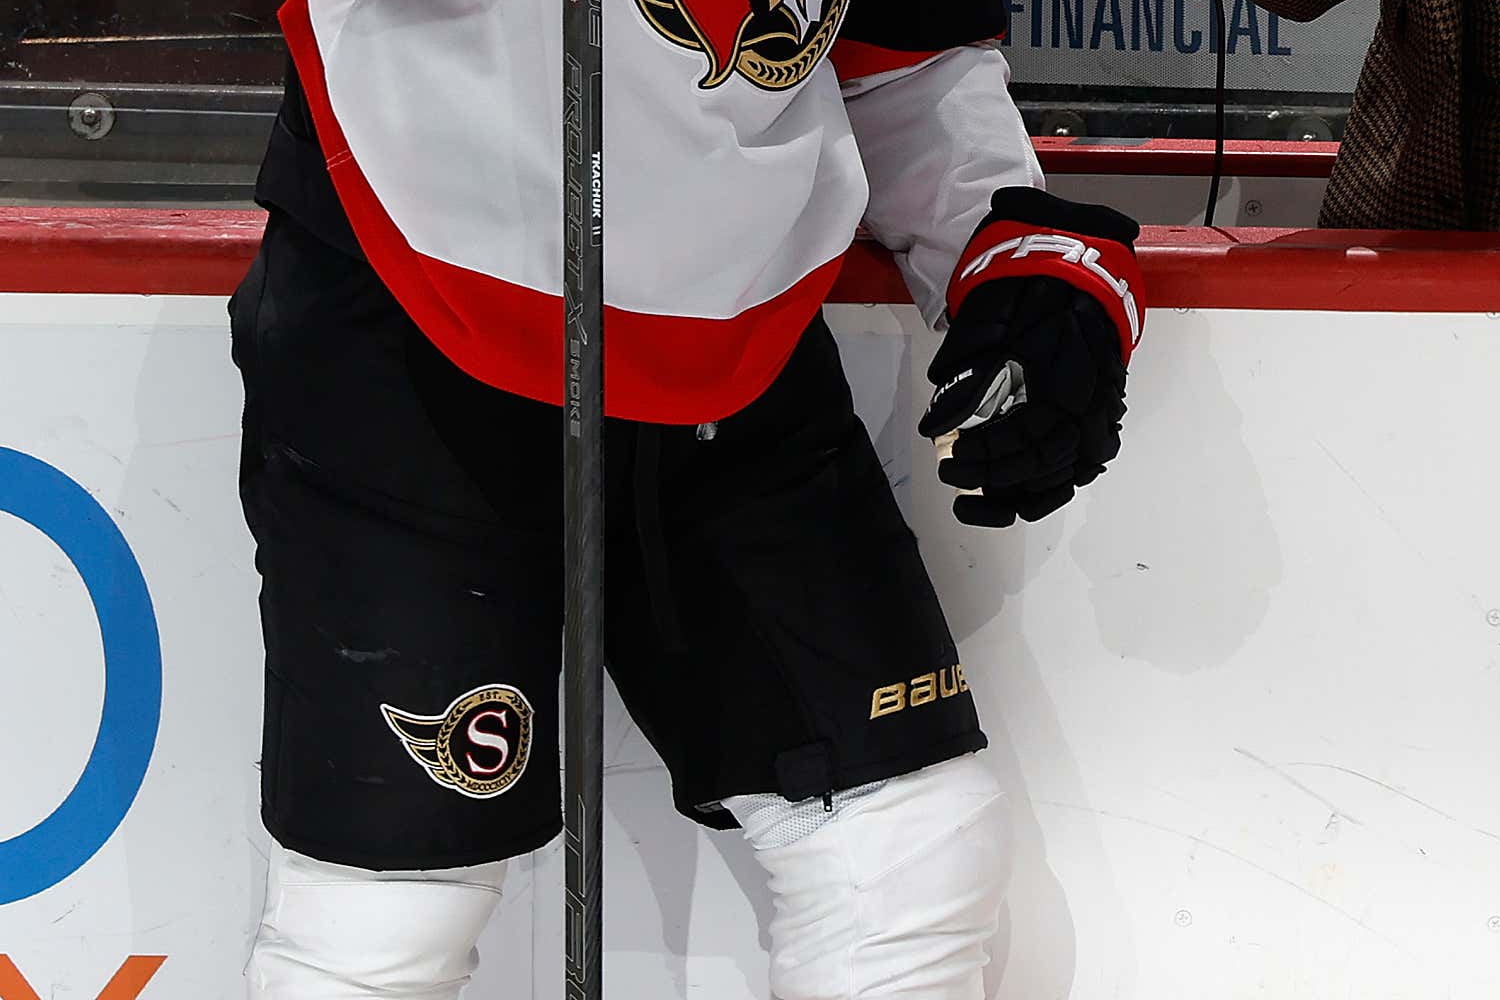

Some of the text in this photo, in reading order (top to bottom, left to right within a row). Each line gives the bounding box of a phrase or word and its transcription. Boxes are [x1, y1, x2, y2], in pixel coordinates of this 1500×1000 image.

[564, 52, 584, 291] PROJECT
[591, 151, 602, 219] TKACHUK
[466, 709, 509, 773] S
